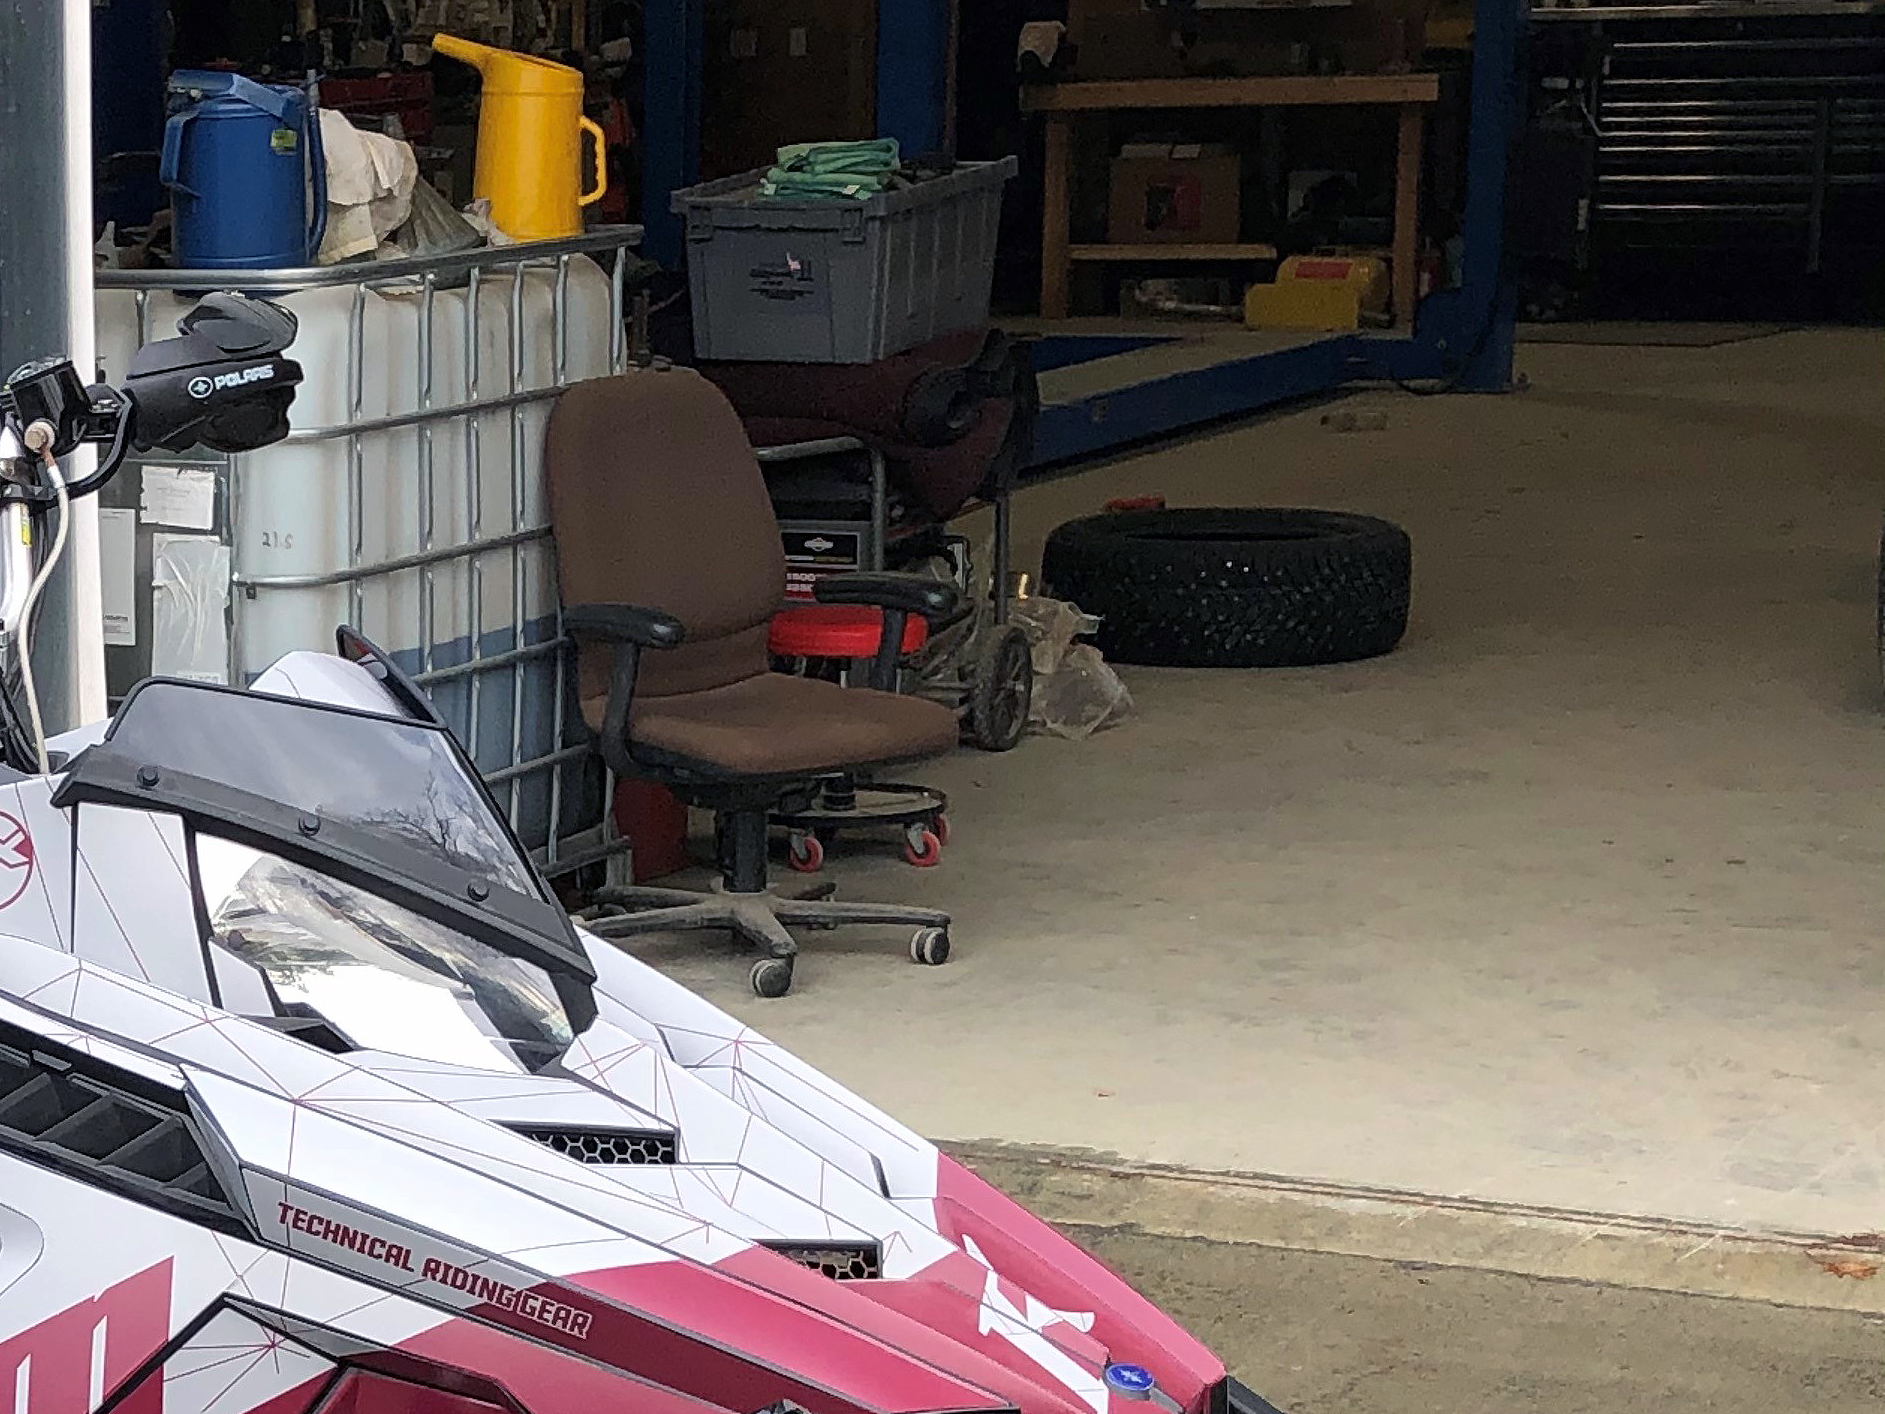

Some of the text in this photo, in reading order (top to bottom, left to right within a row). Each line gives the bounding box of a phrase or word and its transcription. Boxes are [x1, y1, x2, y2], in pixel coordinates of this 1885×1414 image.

[214, 364, 274, 390] POLARIS
[277, 1201, 593, 1340] TECHNICAL RIDING GEAR
